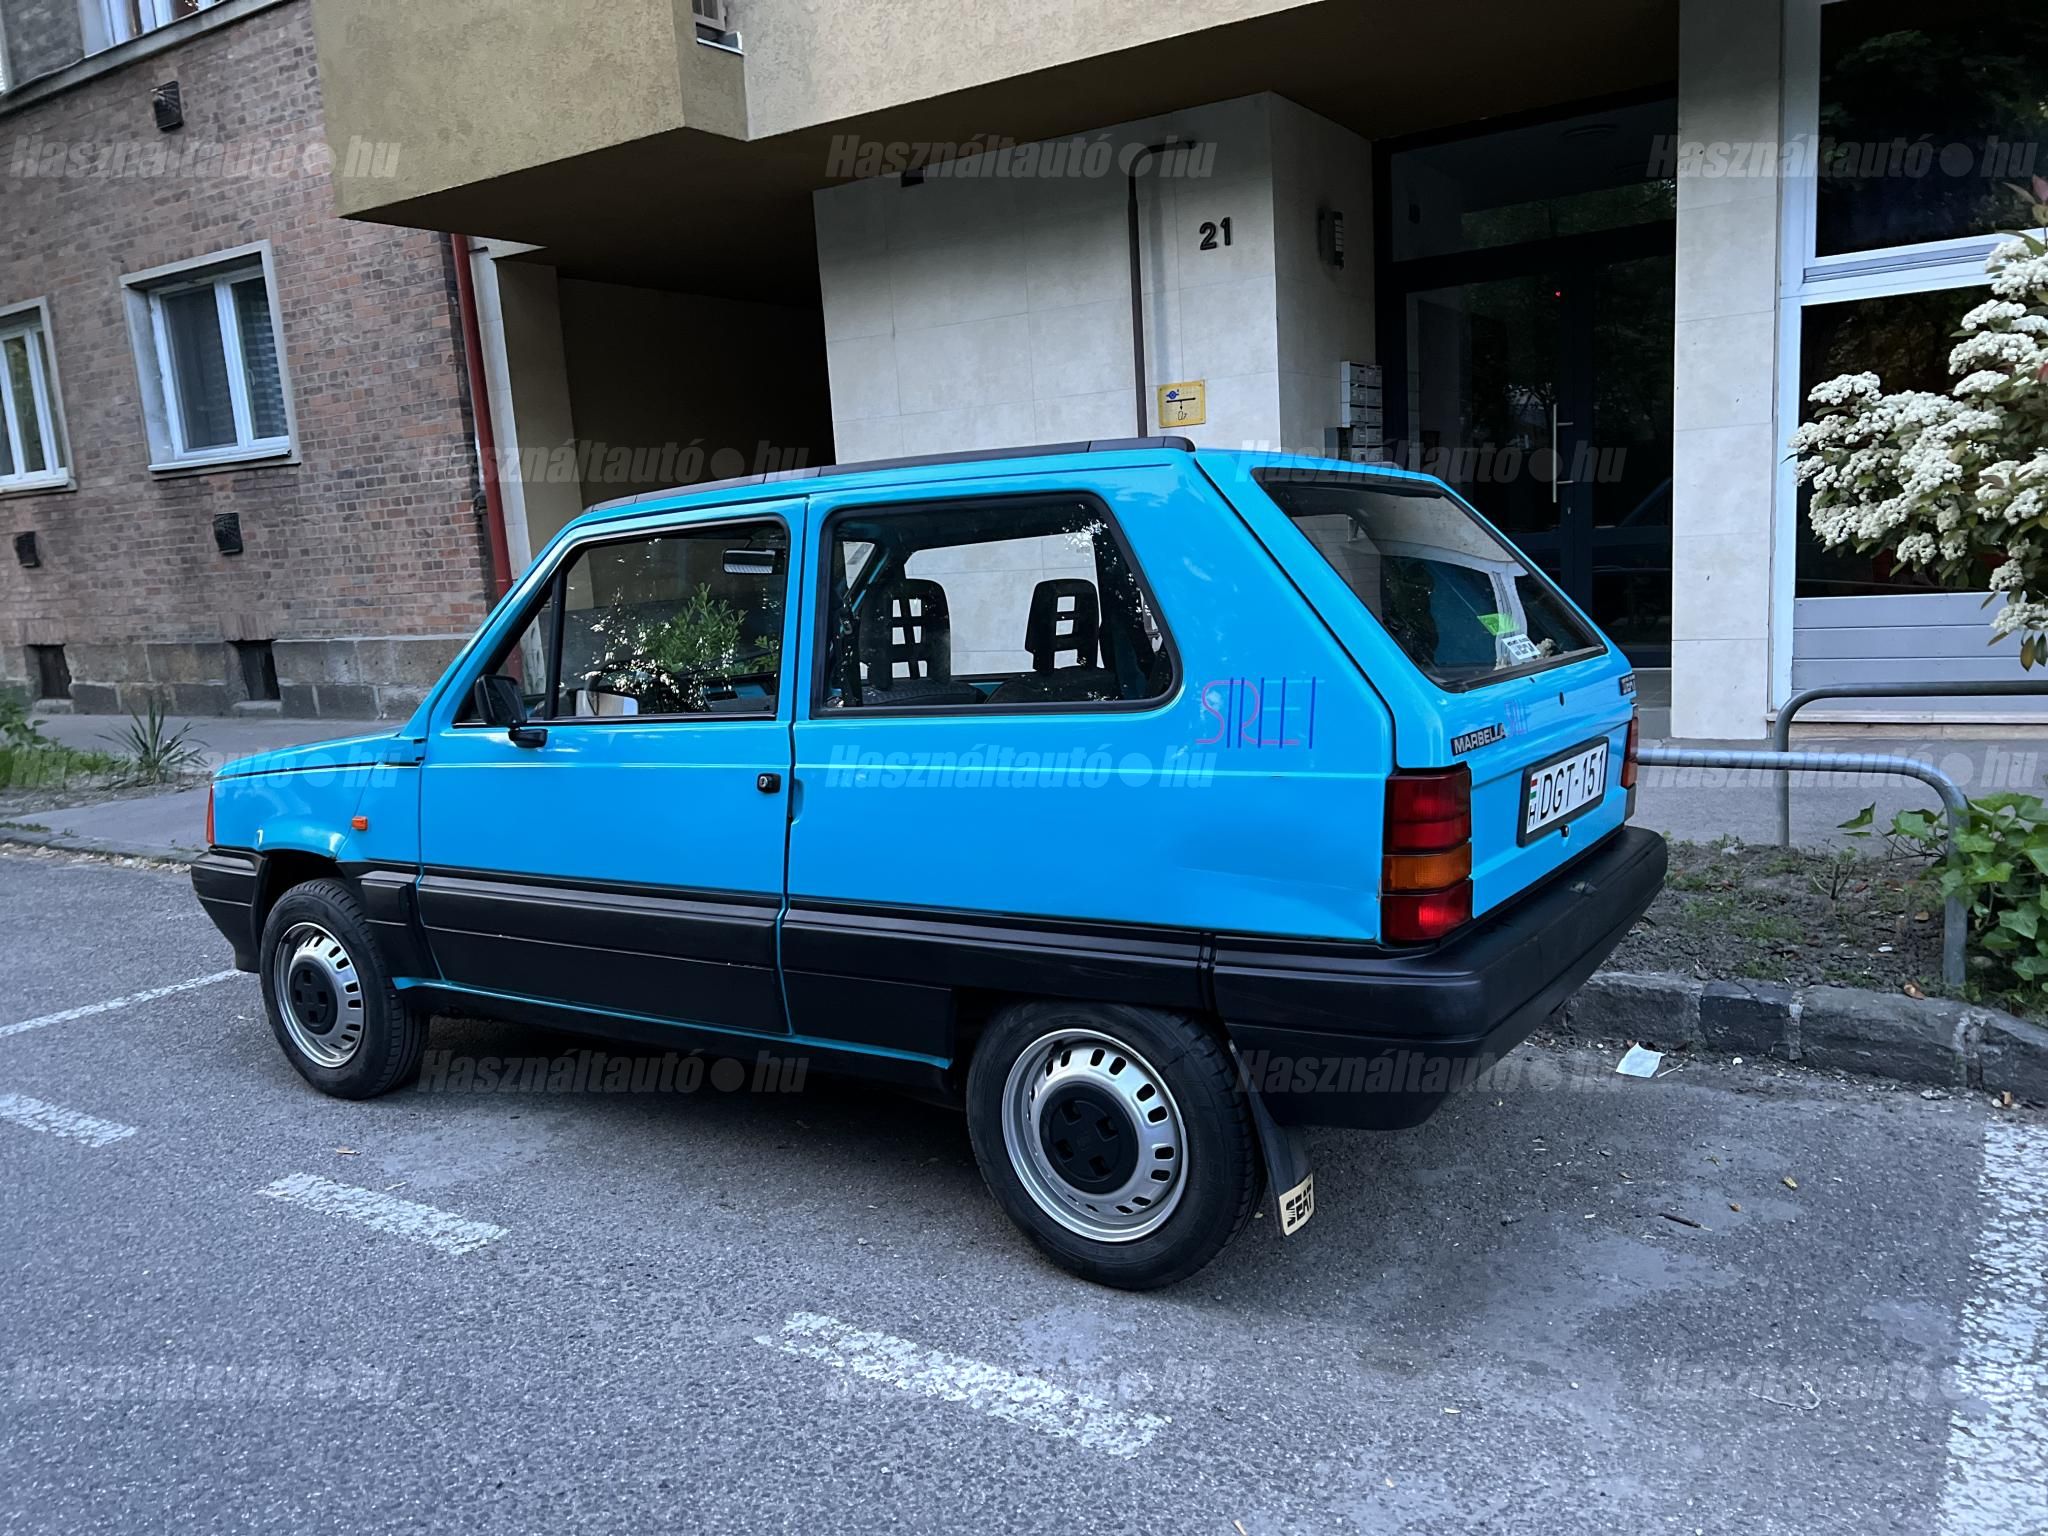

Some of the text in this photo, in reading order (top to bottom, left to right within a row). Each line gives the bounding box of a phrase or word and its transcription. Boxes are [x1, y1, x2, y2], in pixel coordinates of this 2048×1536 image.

[1198, 216, 1231, 250] 21
[1454, 723, 1506, 755] MARBELLA
[1527, 749, 1604, 826] H DGT-151
[1286, 1183, 1311, 1228] SEAT
